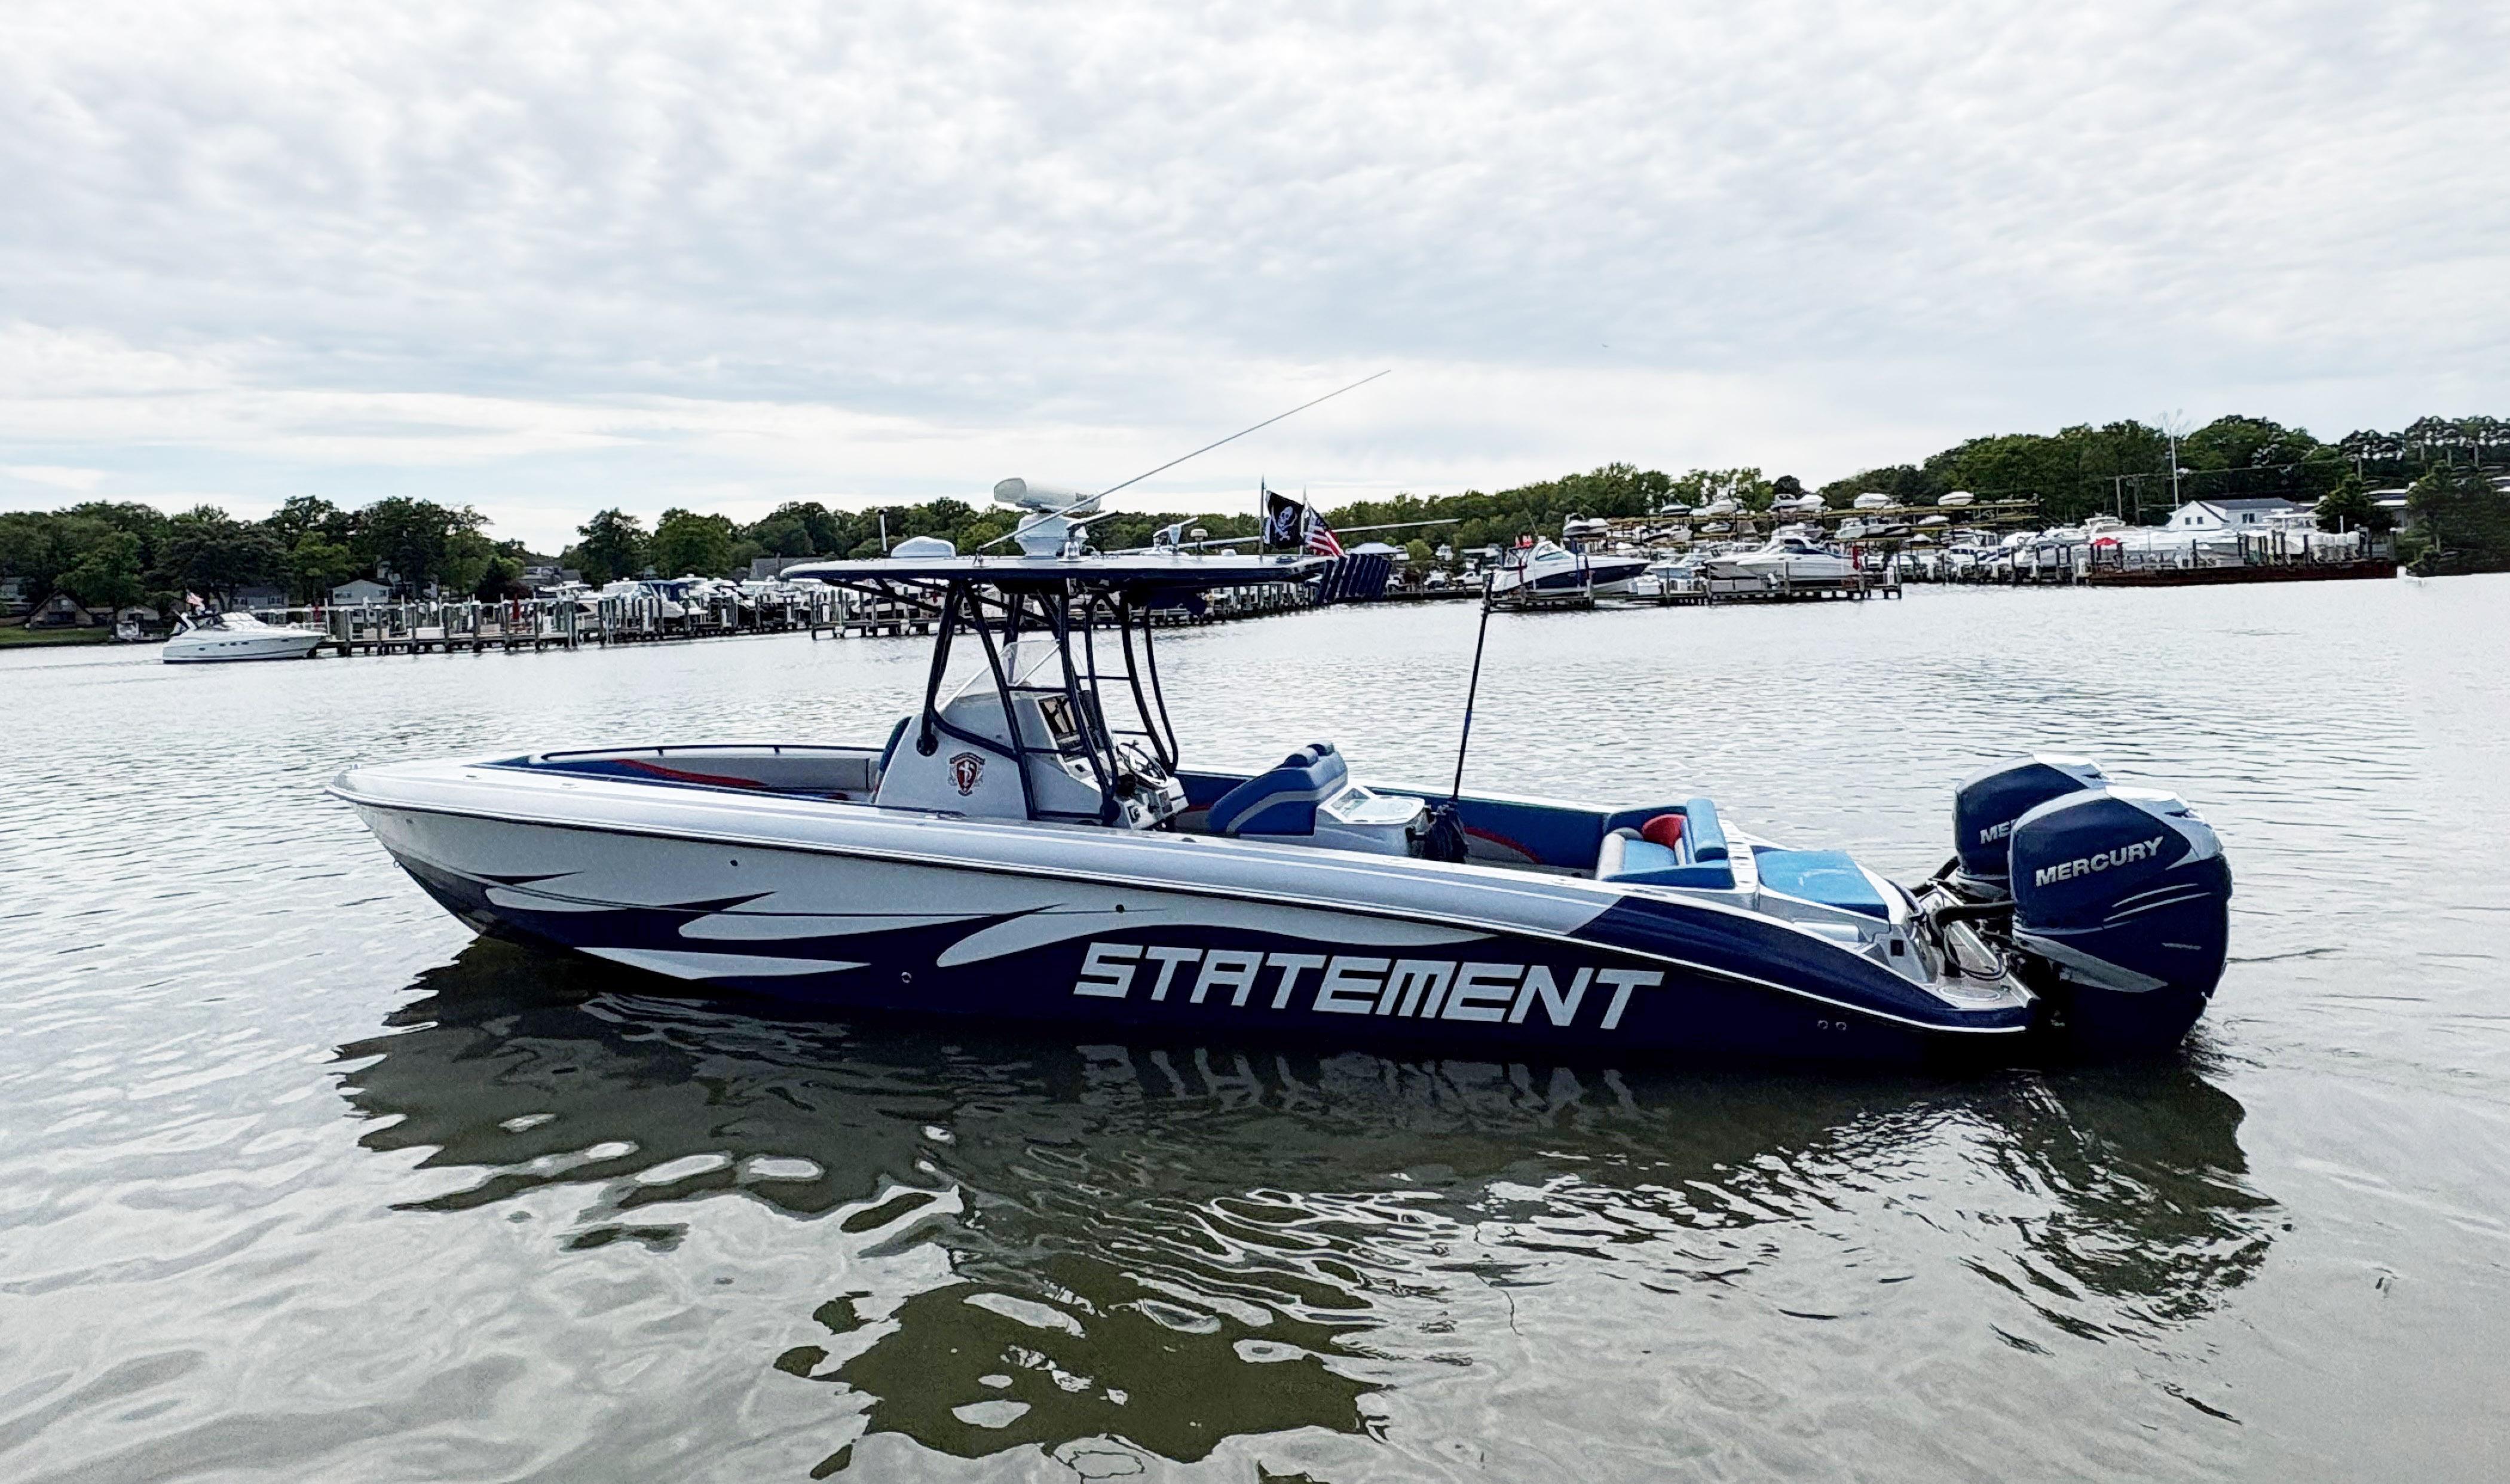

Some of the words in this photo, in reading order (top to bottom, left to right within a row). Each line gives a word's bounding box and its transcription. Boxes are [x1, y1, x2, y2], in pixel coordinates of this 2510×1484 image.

[1979, 819, 2017, 844] ME
[2035, 836, 2163, 887] MERCURY
[1073, 942, 1665, 1029] STATEMENT
